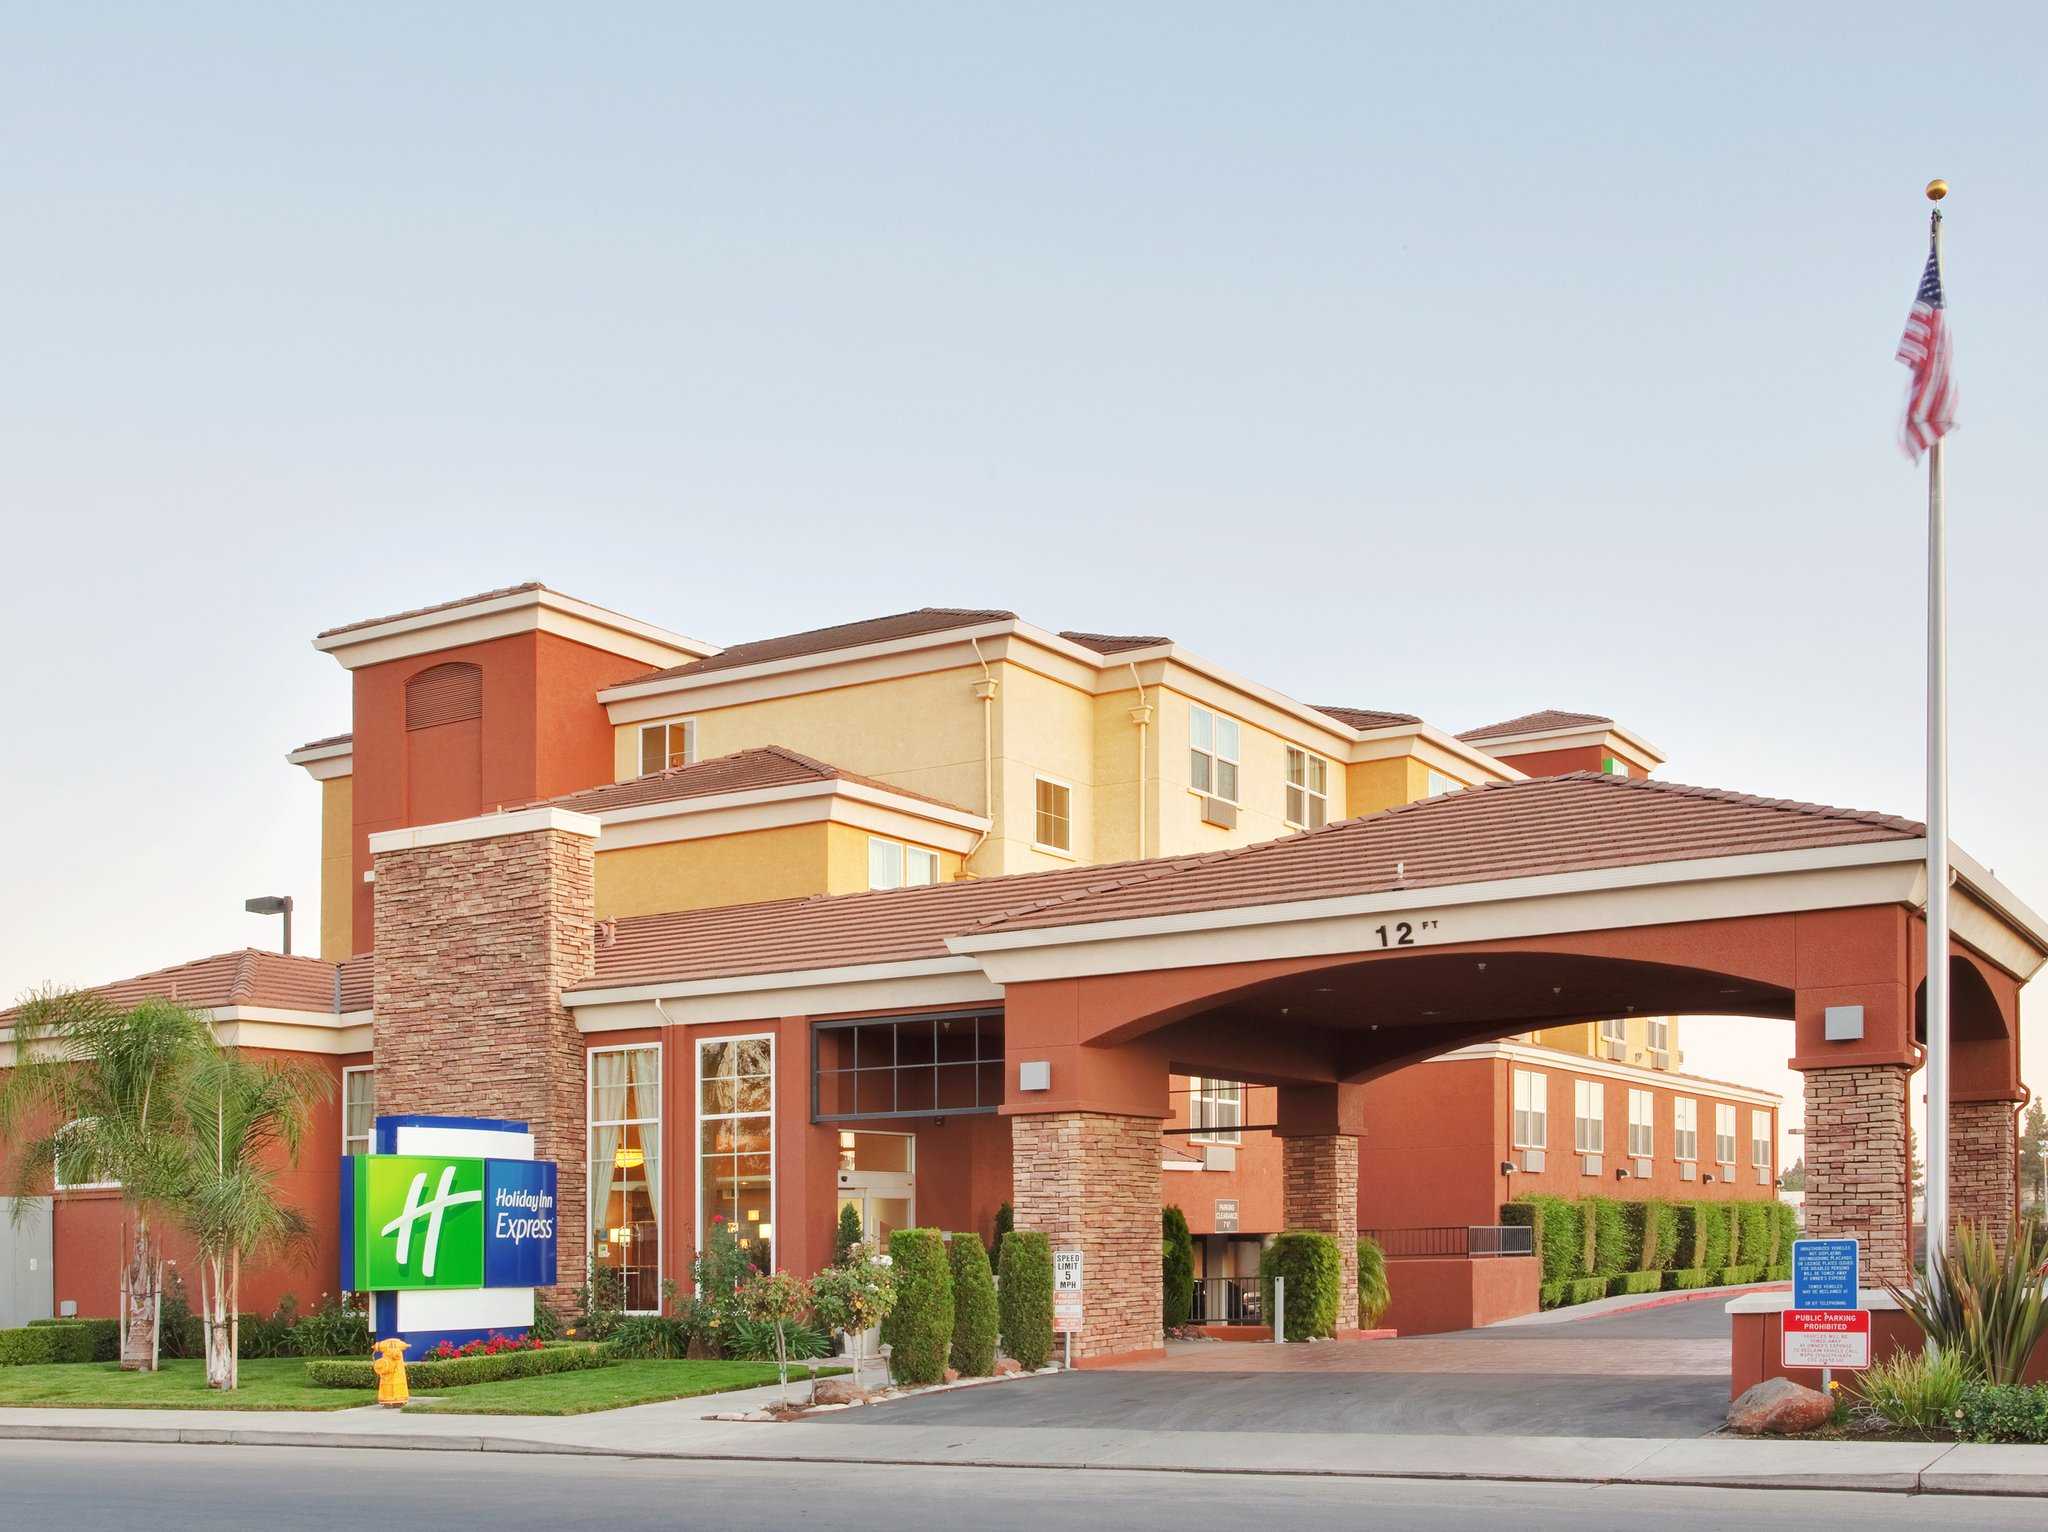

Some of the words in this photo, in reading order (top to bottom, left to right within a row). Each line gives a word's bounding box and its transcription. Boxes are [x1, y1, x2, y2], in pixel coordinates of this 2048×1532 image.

[1375, 921, 1414, 947] 12
[1421, 919, 1439, 930] FT
[495, 1187, 539, 1213] Holiday
[539, 1189, 553, 1209] Inn
[495, 1212, 553, 1246] Express
[1056, 1254, 1080, 1262] SPEED
[1057, 1262, 1079, 1271] LIMIT
[1065, 1271, 1071, 1280] 5
[1060, 1281, 1077, 1289] MPH
[1795, 1314, 1822, 1322] PUBLIC
[1824, 1314, 1857, 1322] PARKING
